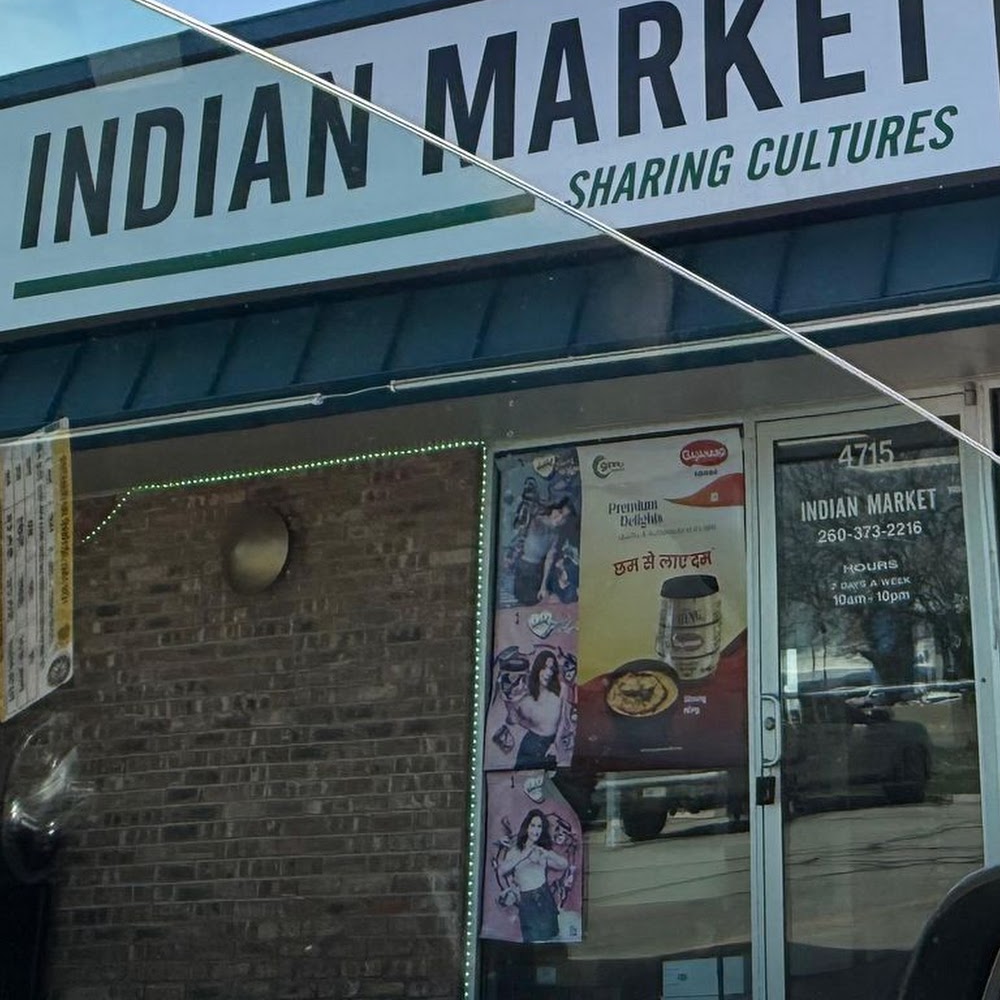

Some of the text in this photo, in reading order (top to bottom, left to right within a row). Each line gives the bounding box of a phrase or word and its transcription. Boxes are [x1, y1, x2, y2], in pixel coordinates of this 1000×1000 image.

[19, 62, 374, 250] INDIAN
[566, 105, 959, 208] SHARING CULTURES
[838, 439, 895, 469] 4715
[801, 488, 937, 522] INDIAN MARKET
[817, 520, 923, 544] 260-373-2216
[641, 550, 656, 571] से
[843, 559, 899, 574] HOURS
[840, 579, 867, 591] DAYS
[869, 579, 878, 588] A
[881, 576, 912, 587] WEEK
